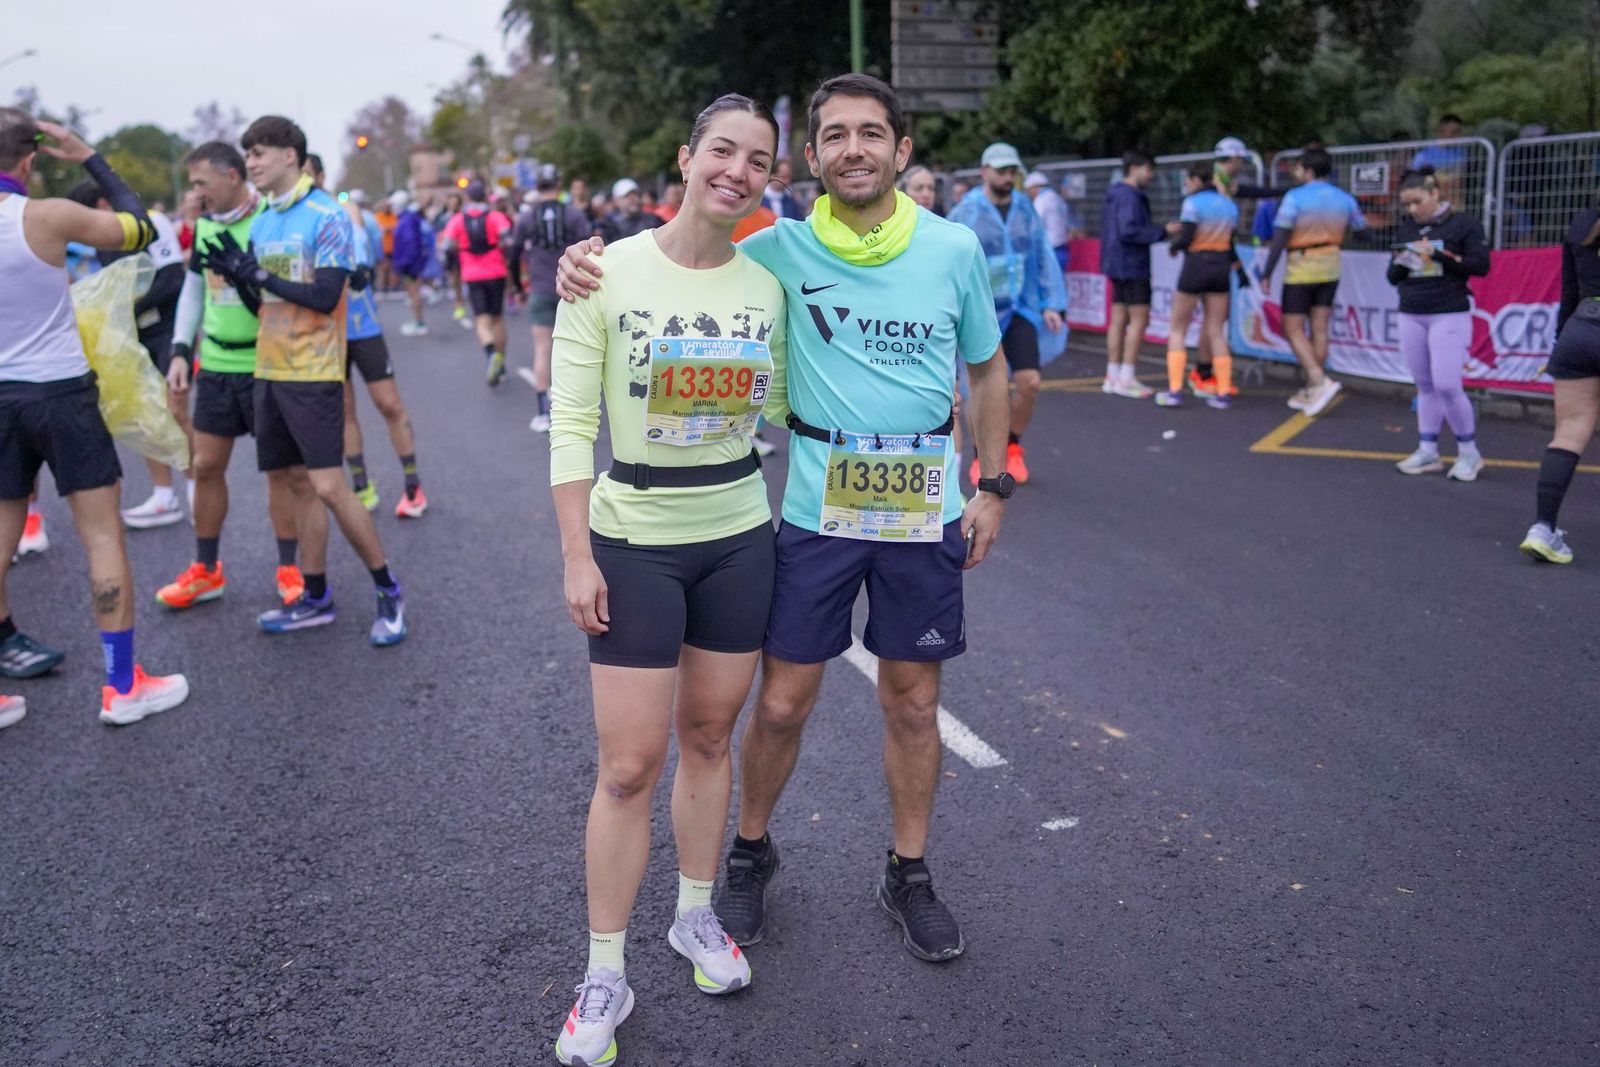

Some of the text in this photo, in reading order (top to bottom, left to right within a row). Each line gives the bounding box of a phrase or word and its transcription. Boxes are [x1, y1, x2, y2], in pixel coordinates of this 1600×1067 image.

[856, 318, 935, 340] VICKY
[864, 340, 926, 354] FOODS
[869, 358, 923, 366] ATHLETICS
[660, 365, 754, 399] 13339
[836, 458, 926, 494] 13338
[849, 502, 870, 512] Miguel
[916, 638, 946, 646] adidas
